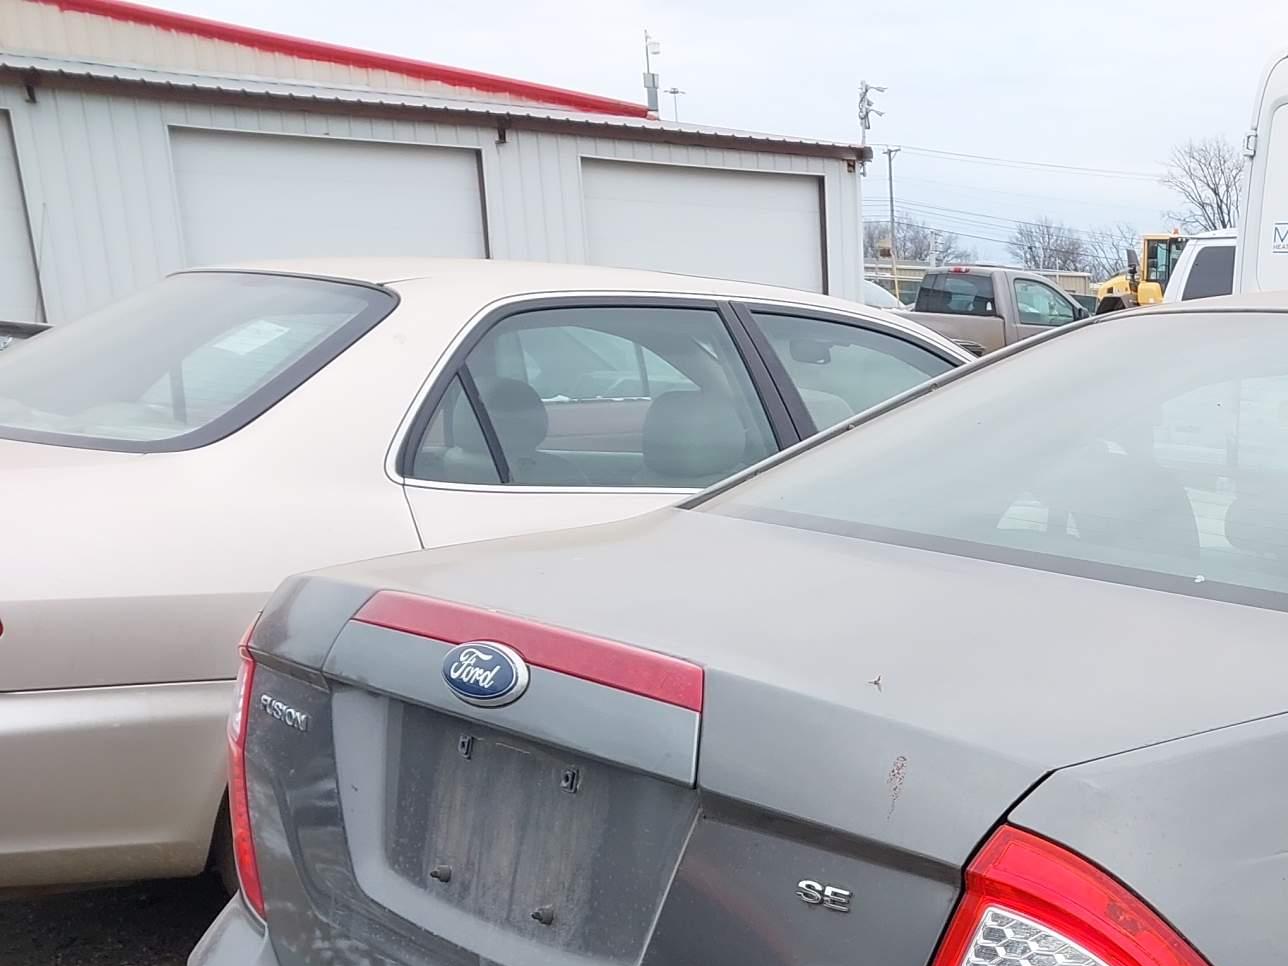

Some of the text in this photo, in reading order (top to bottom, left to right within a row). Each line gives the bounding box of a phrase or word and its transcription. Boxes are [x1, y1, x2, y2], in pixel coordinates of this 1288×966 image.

[449, 648, 502, 690] Ford
[260, 694, 312, 731] FUSION
[796, 879, 852, 912] SE
